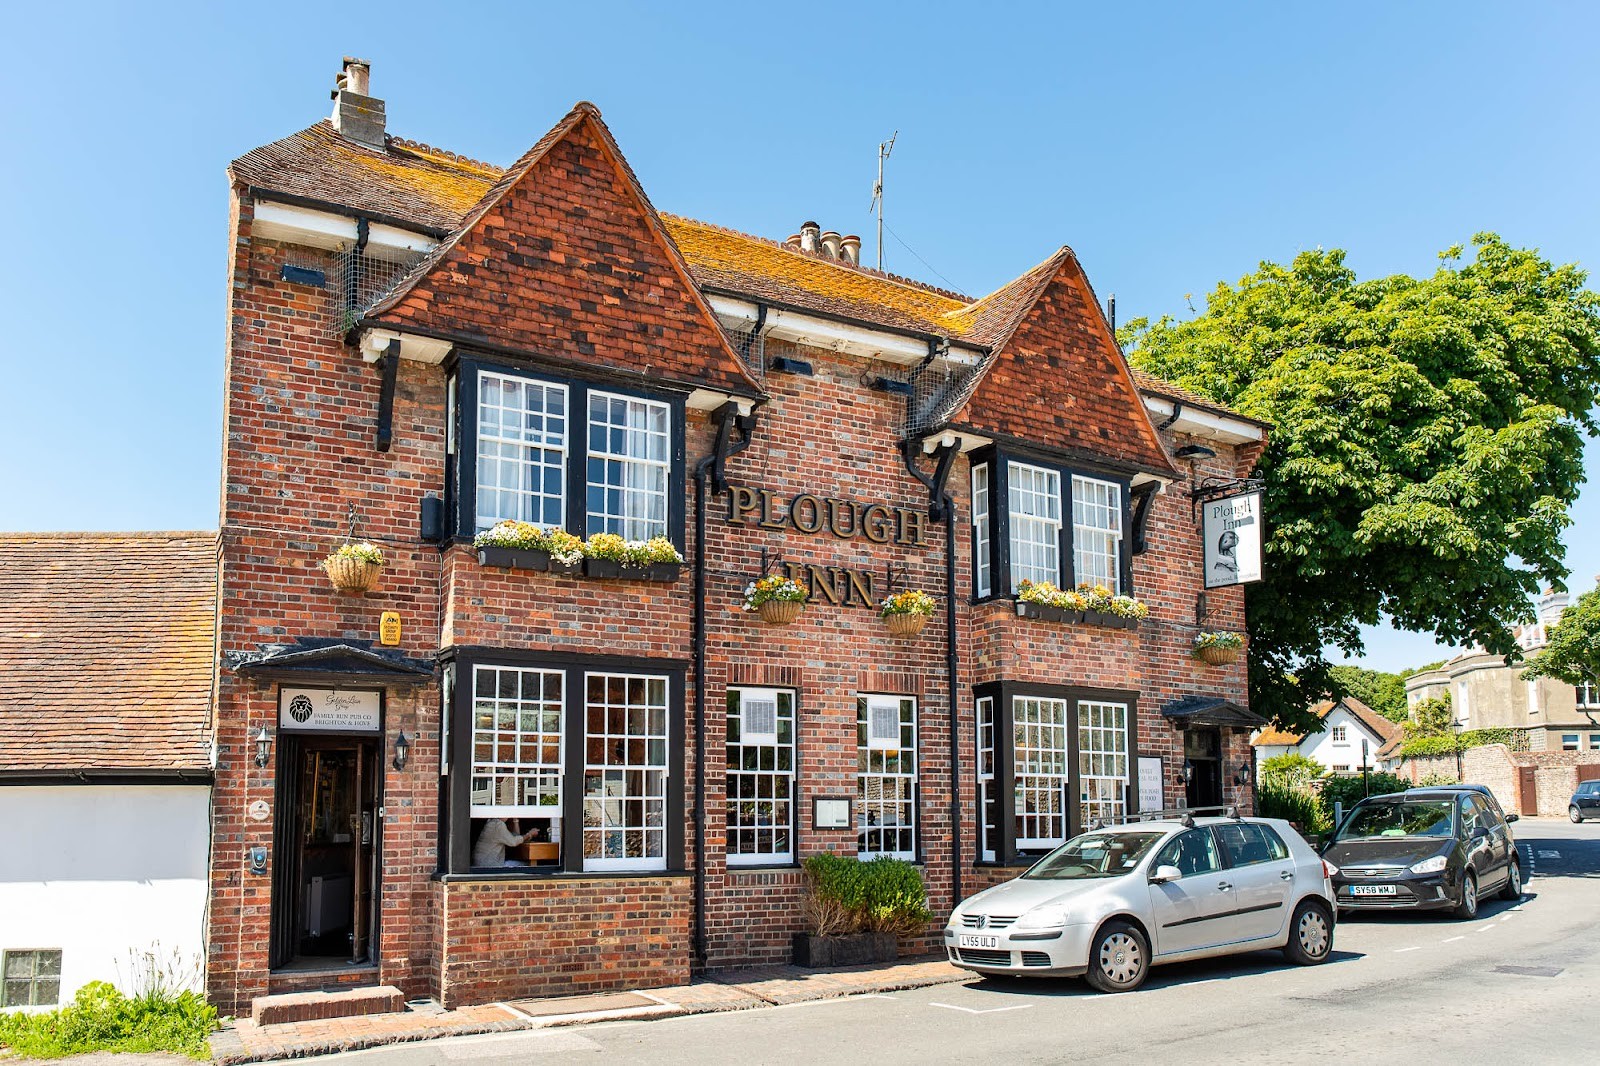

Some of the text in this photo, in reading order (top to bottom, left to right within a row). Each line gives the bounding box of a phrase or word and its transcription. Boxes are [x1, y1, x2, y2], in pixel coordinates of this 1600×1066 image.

[1213, 500, 1251, 519] Plough
[725, 484, 929, 548] PLOUGH
[1223, 518, 1242, 530] Inn
[1355, 886, 1376, 894] SY58
[962, 936, 996, 948] LY55 ULD
